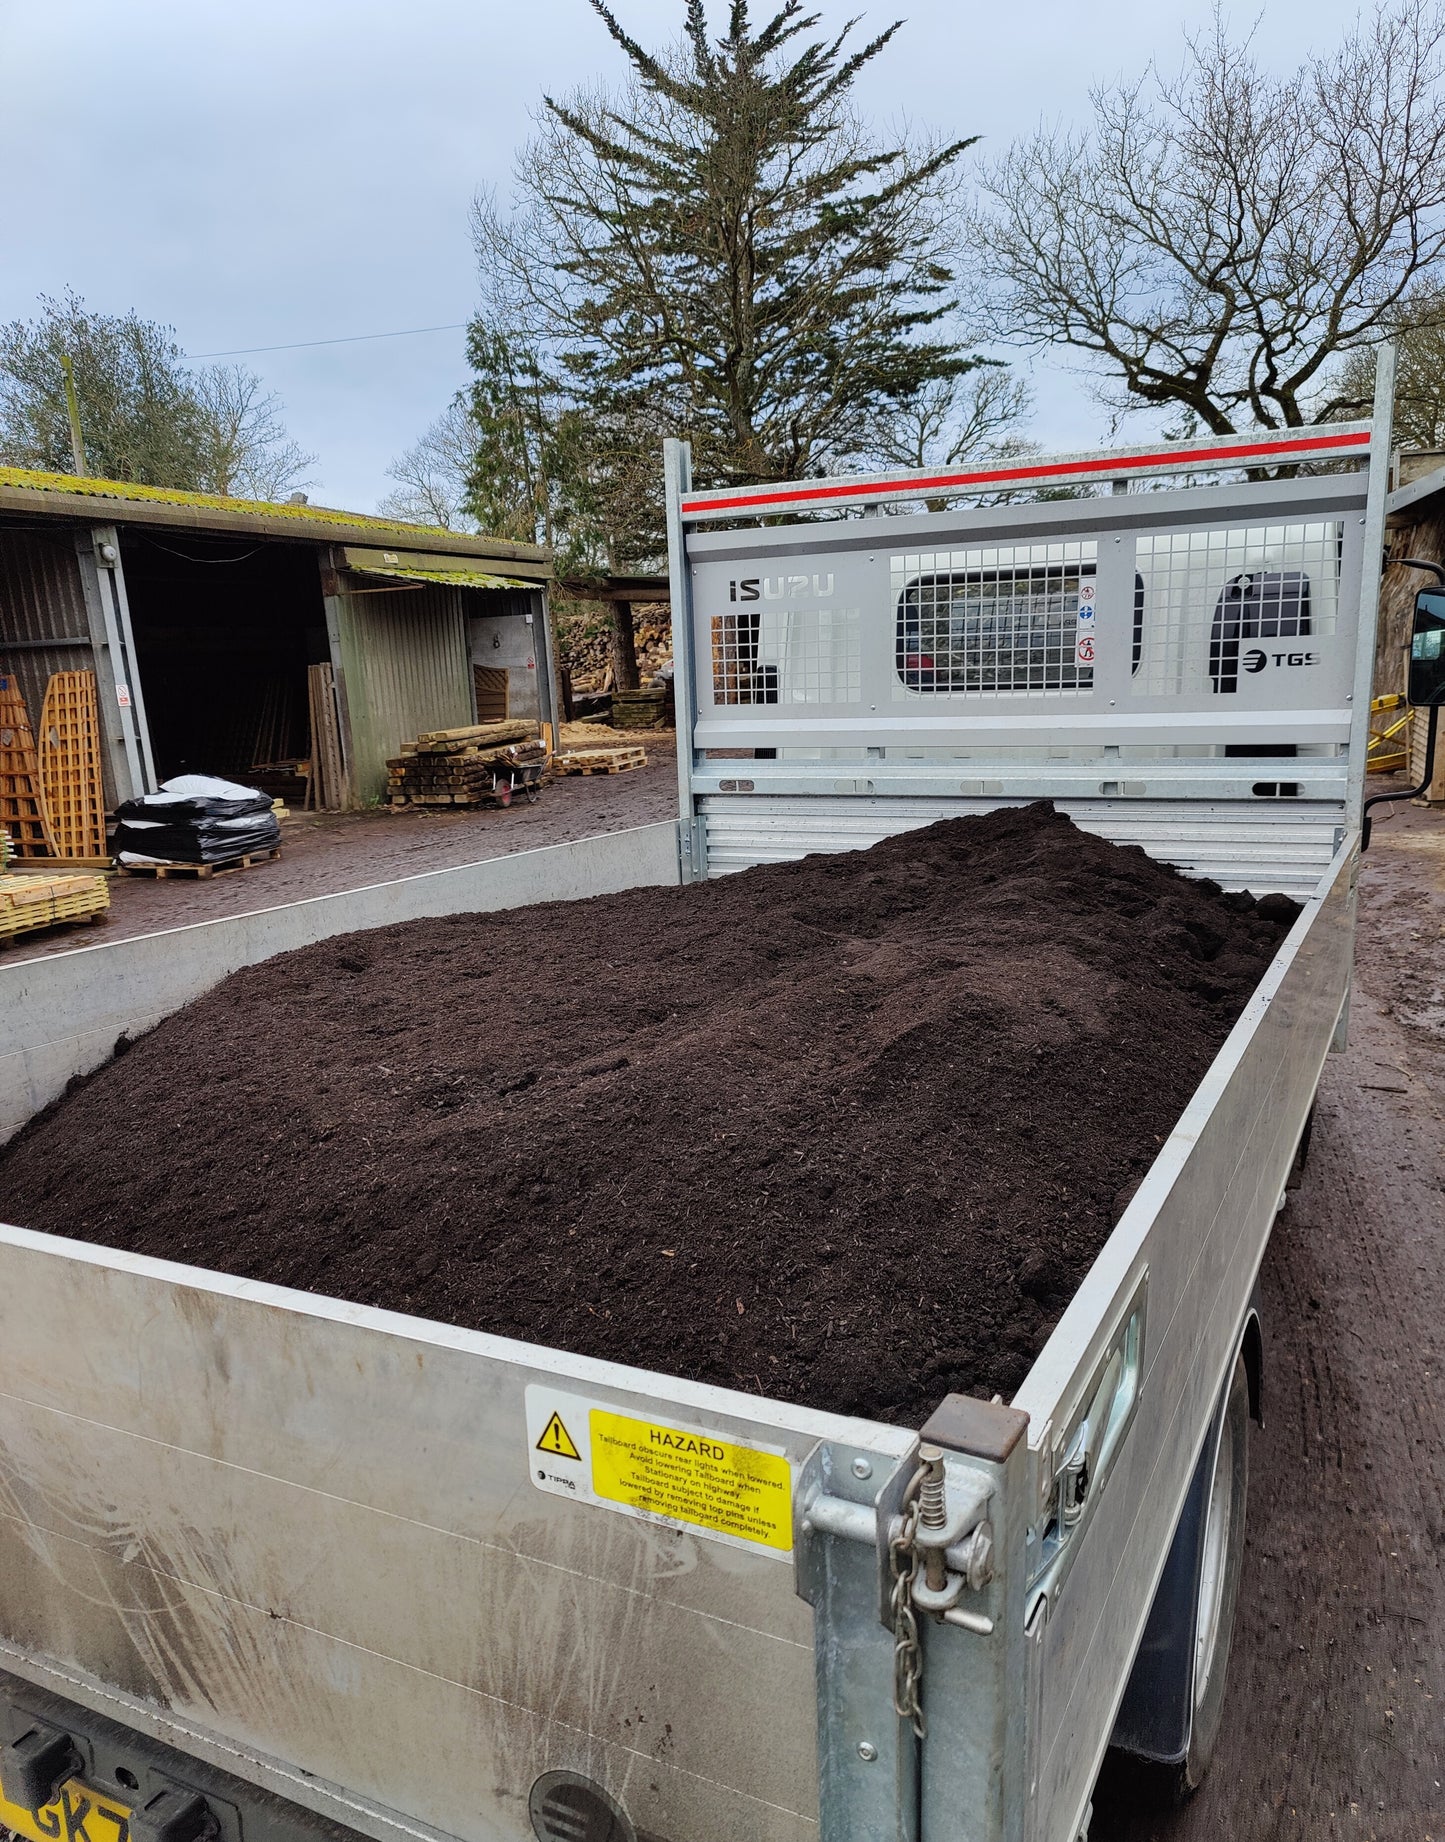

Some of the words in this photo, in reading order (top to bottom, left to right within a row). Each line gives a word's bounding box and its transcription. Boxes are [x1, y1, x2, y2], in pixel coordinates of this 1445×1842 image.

[730, 573, 834, 602] ISUZU
[1271, 653, 1321, 667] TGS
[599, 1433, 636, 1450] Tailboard
[638, 1445, 673, 1460] obscure
[675, 1455, 692, 1465] rear
[694, 1460, 719, 1472] lights
[722, 1467, 745, 1480] when
[747, 1473, 785, 1490] lowered.
[650, 1429, 724, 1461] HAZARD
[629, 1452, 653, 1465] Avoid
[655, 1459, 692, 1476] lowering
[695, 1469, 734, 1487] Tailboard
[737, 1482, 761, 1494] when
[631, 1472, 669, 1488] Tailboard
[671, 1484, 703, 1499] subject
[705, 1492, 714, 1501] to
[716, 1496, 751, 1511] damage
[753, 1506, 760, 1514] if
[645, 1466, 687, 1485] Stationary
[690, 1480, 701, 1488] on
[703, 1482, 741, 1500] highway.
[620, 1478, 652, 1494] lowered
[654, 1488, 664, 1499] by
[667, 1493, 706, 1511] removing
[709, 1503, 724, 1515] top
[725, 1510, 745, 1521] pins
[747, 1515, 777, 1530] unless
[639, 1495, 678, 1513] removing
[680, 1505, 719, 1522] tailboard
[720, 1518, 771, 1539] completely.
